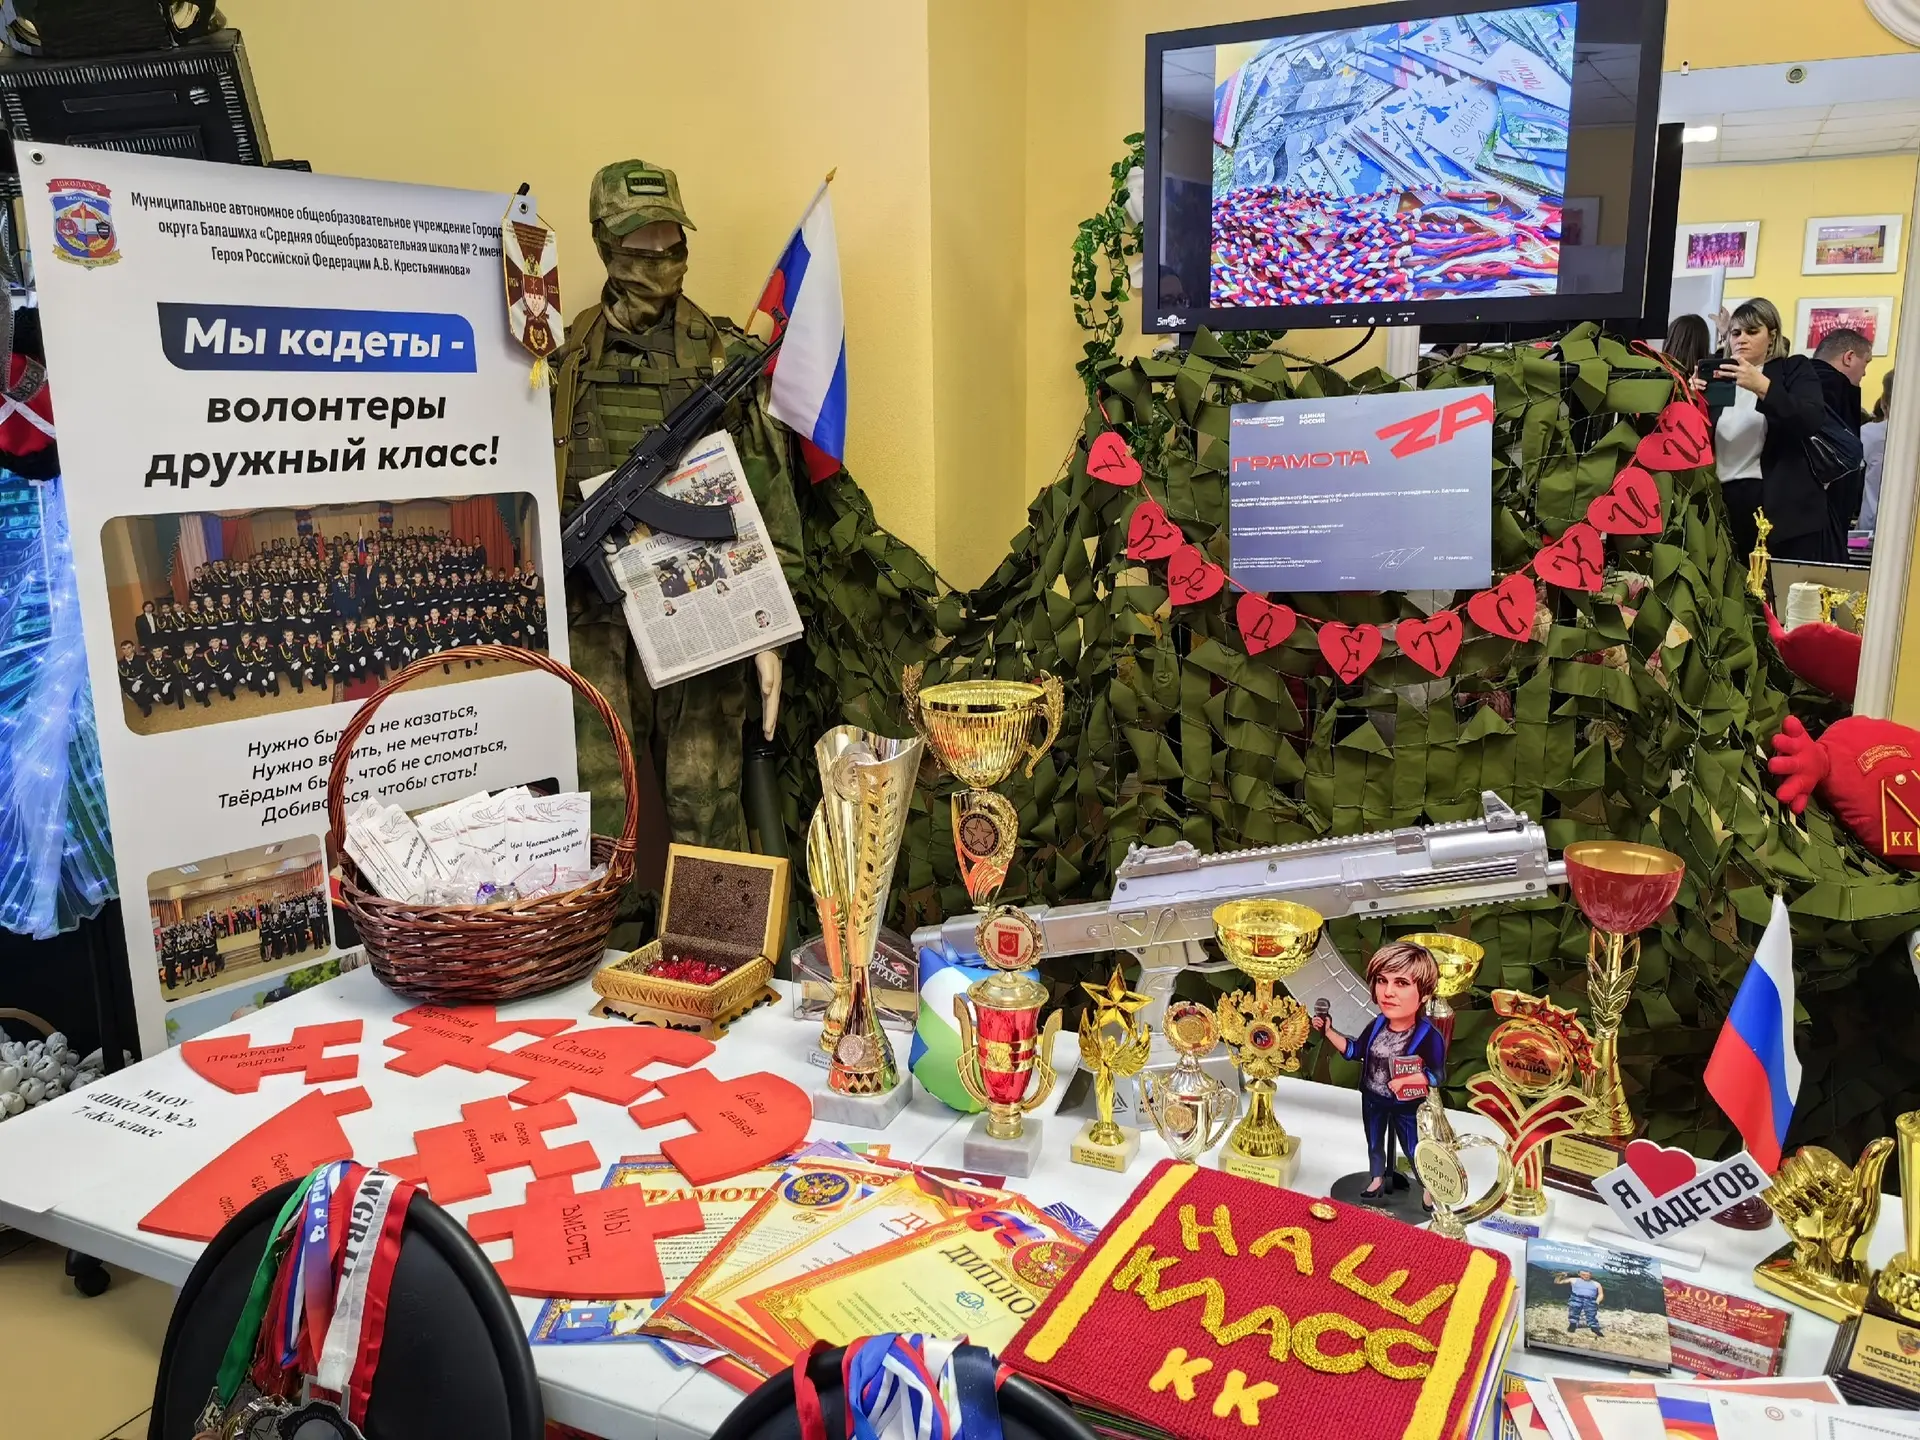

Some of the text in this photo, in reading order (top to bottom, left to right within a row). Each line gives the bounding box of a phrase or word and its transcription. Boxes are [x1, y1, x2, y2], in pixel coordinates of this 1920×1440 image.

[131, 191, 226, 214] Муниципальное
[229, 202, 294, 219] автономное
[297, 206, 411, 230] общеобразовательное
[413, 218, 471, 238] учреждение
[158, 221, 198, 238] округа
[200, 222, 257, 240] Балашиха
[260, 226, 312, 244] «Средняя
[314, 230, 427, 252] общеобразовательная
[429, 241, 459, 255] школа
[461, 242, 471, 254] №
[472, 243, 478, 256] 2
[211, 246, 471, 276] Героя Российской Федерации А.В. Крестьянинова»
[184, 316, 265, 355] Мы
[280, 323, 440, 364] кадеты
[206, 395, 447, 429] волонтеры
[144, 435, 500, 489] дружный класс!
[1231, 449, 1371, 473] ГРАМОТА
[247, 736, 309, 759] Нужно
[364, 724, 375, 735] а
[380, 719, 400, 733] не
[404, 705, 478, 729] казаться,
[252, 722, 478, 781] Нужно веить, не мечтать!
[218, 740, 507, 809] Твёрдым быь, чтоб не сломаться,
[378, 776, 427, 796] чтобы
[431, 762, 478, 786] стать!
[560, 827, 579, 839] добра
[87, 1092, 161, 1120] «ШКОЛА
[140, 1089, 193, 1108] МАОУ
[1403, 1087, 1425, 1097] ПЕРВЫХ
[72, 1105, 91, 1115] 7
[114, 1119, 163, 1138] класс
[1422, 1161, 1455, 1185] доброе
[1433, 1153, 1444, 1167] За
[1423, 1173, 1455, 1198] сердце
[1611, 1177, 1642, 1212] Я
[1632, 1162, 1760, 1241] КАДЕТОВ
[562, 1203, 591, 1266] ВМЕСТЕ
[603, 1207, 632, 1237] МЫ
[1178, 1203, 1456, 1325] НАШ
[1112, 1244, 1439, 1381] КЛАСС
[1684, 1286, 1728, 1307] 100
